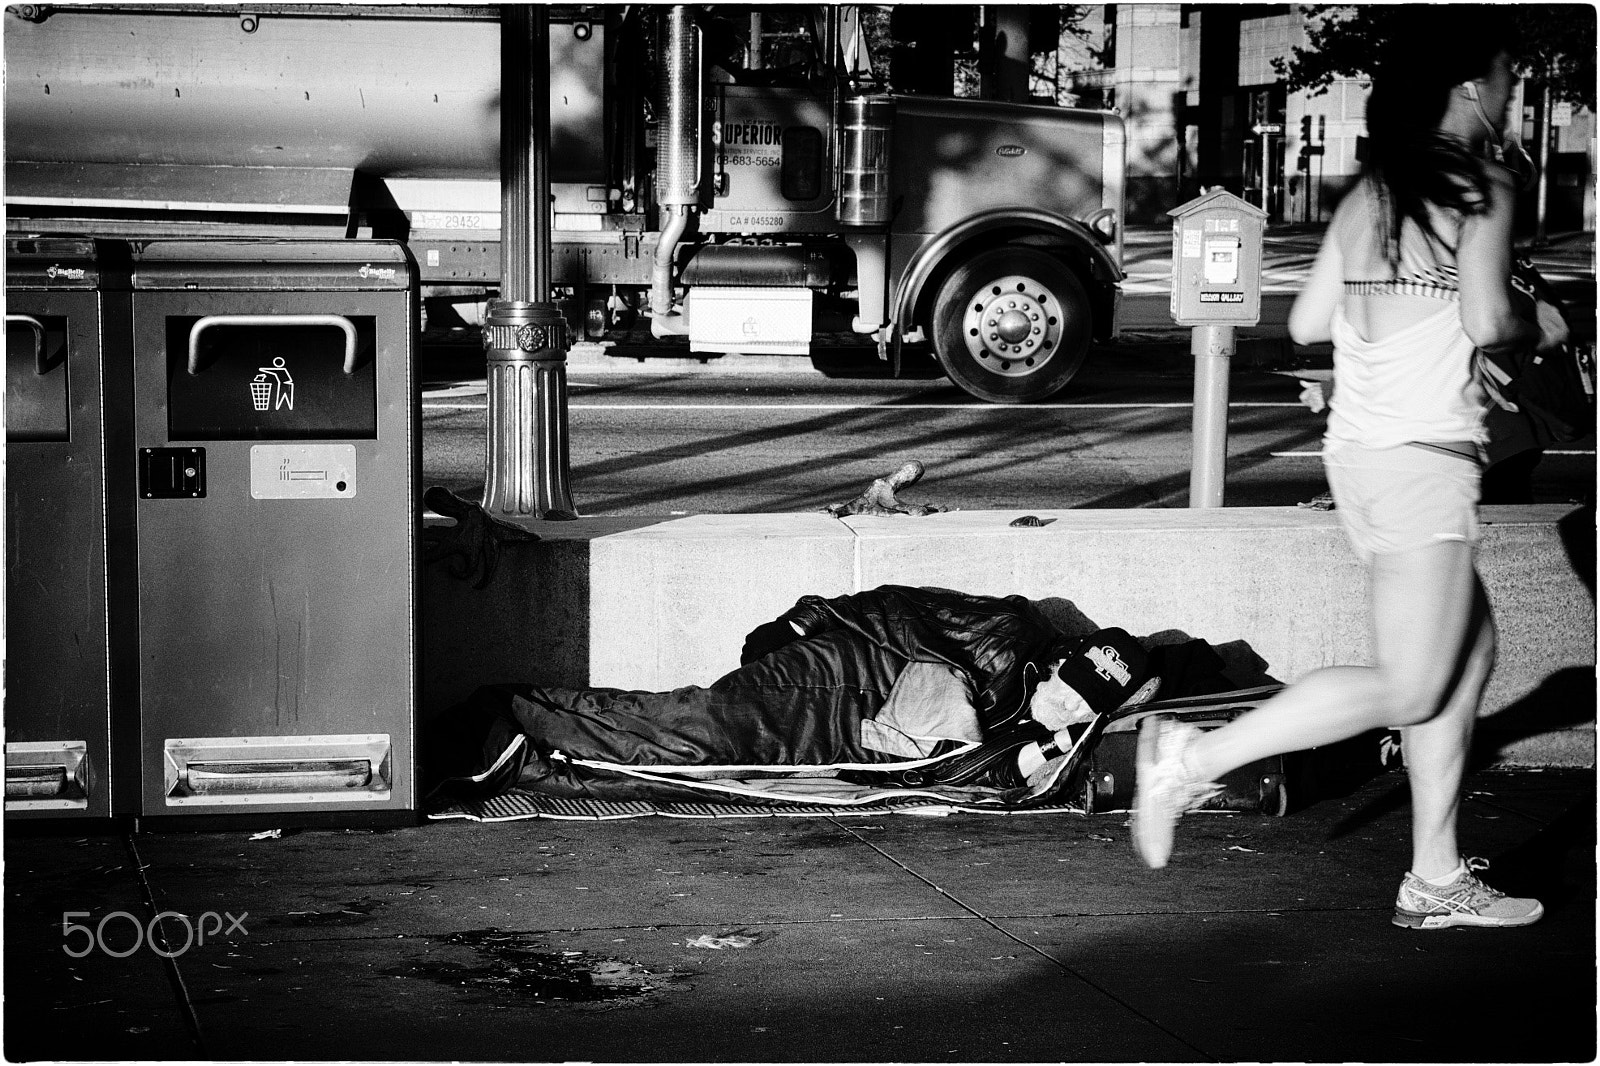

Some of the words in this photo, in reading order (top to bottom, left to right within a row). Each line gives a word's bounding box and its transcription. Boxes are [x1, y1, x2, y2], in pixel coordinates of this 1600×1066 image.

[712, 121, 781, 145] SUPERIOR
[713, 155, 781, 167] 08-683-5654
[445, 215, 480, 228] 29432
[730, 216, 742, 226] CA
[750, 216, 784, 226] 0455280
